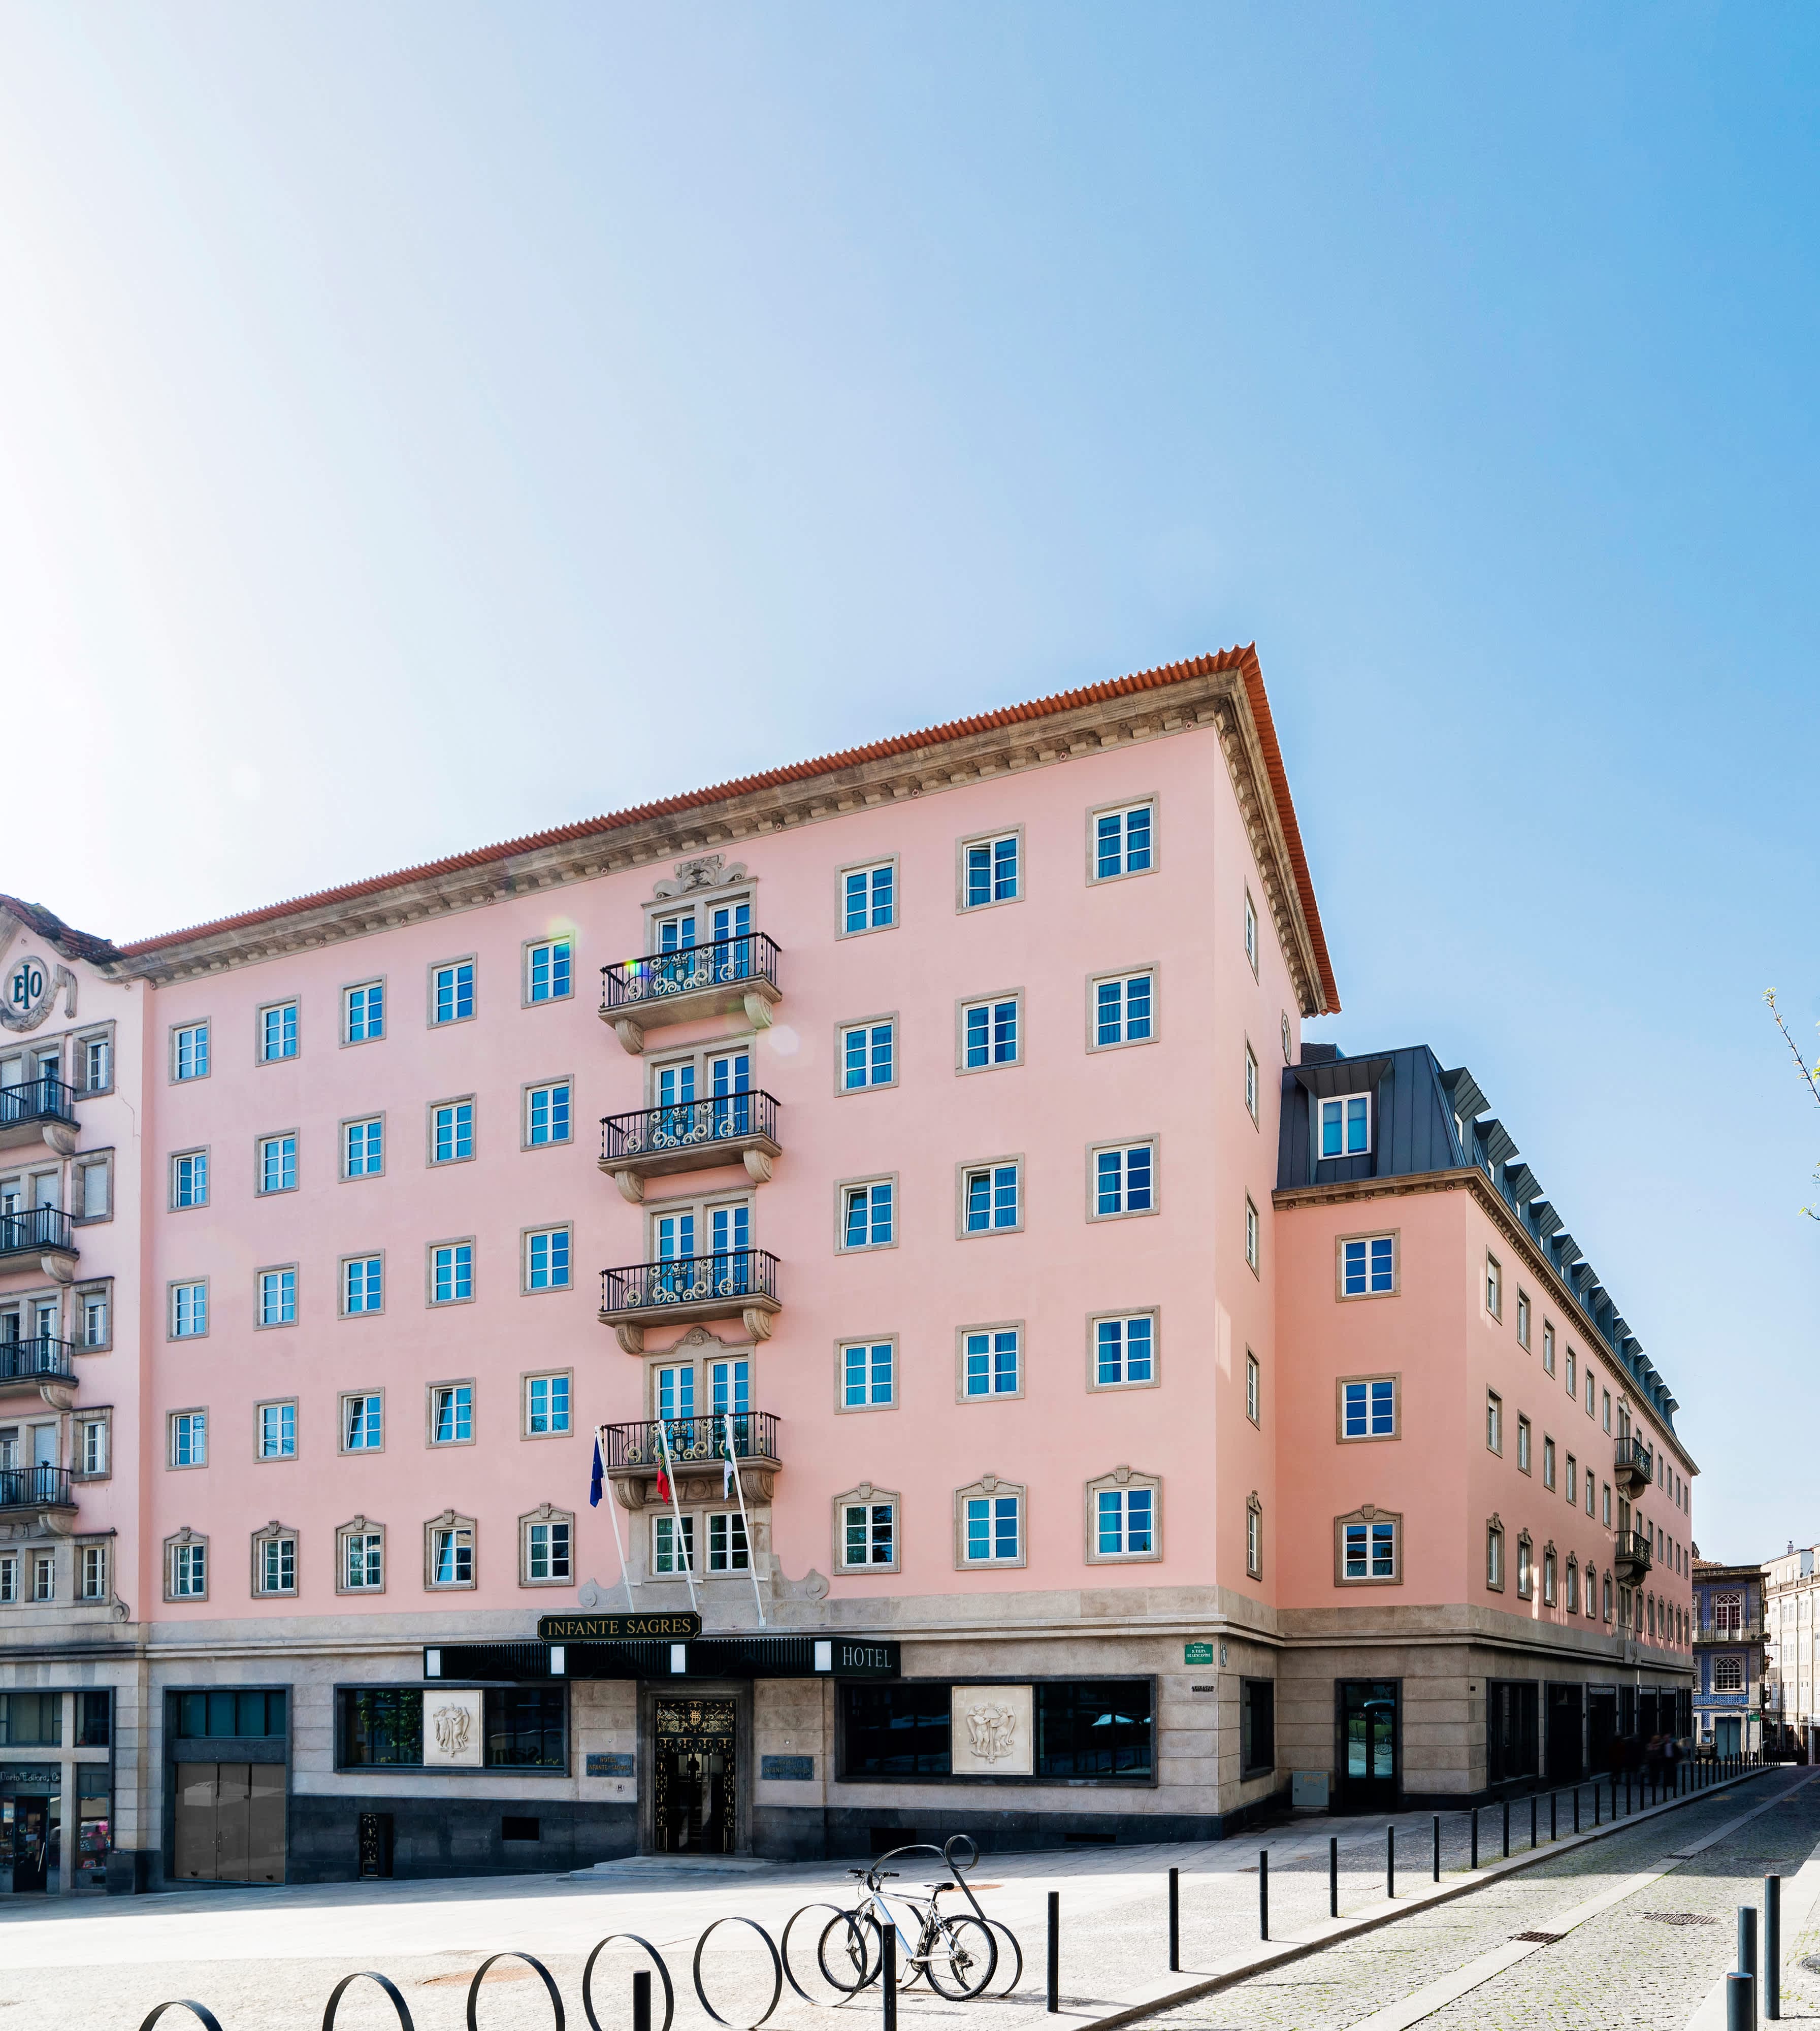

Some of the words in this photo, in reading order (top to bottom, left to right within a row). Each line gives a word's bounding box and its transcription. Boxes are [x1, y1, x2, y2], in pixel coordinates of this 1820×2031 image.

[547, 1620, 619, 1635] INFANTE
[627, 1618, 691, 1633] SAGRES
[842, 1646, 892, 1667] HOTEL
